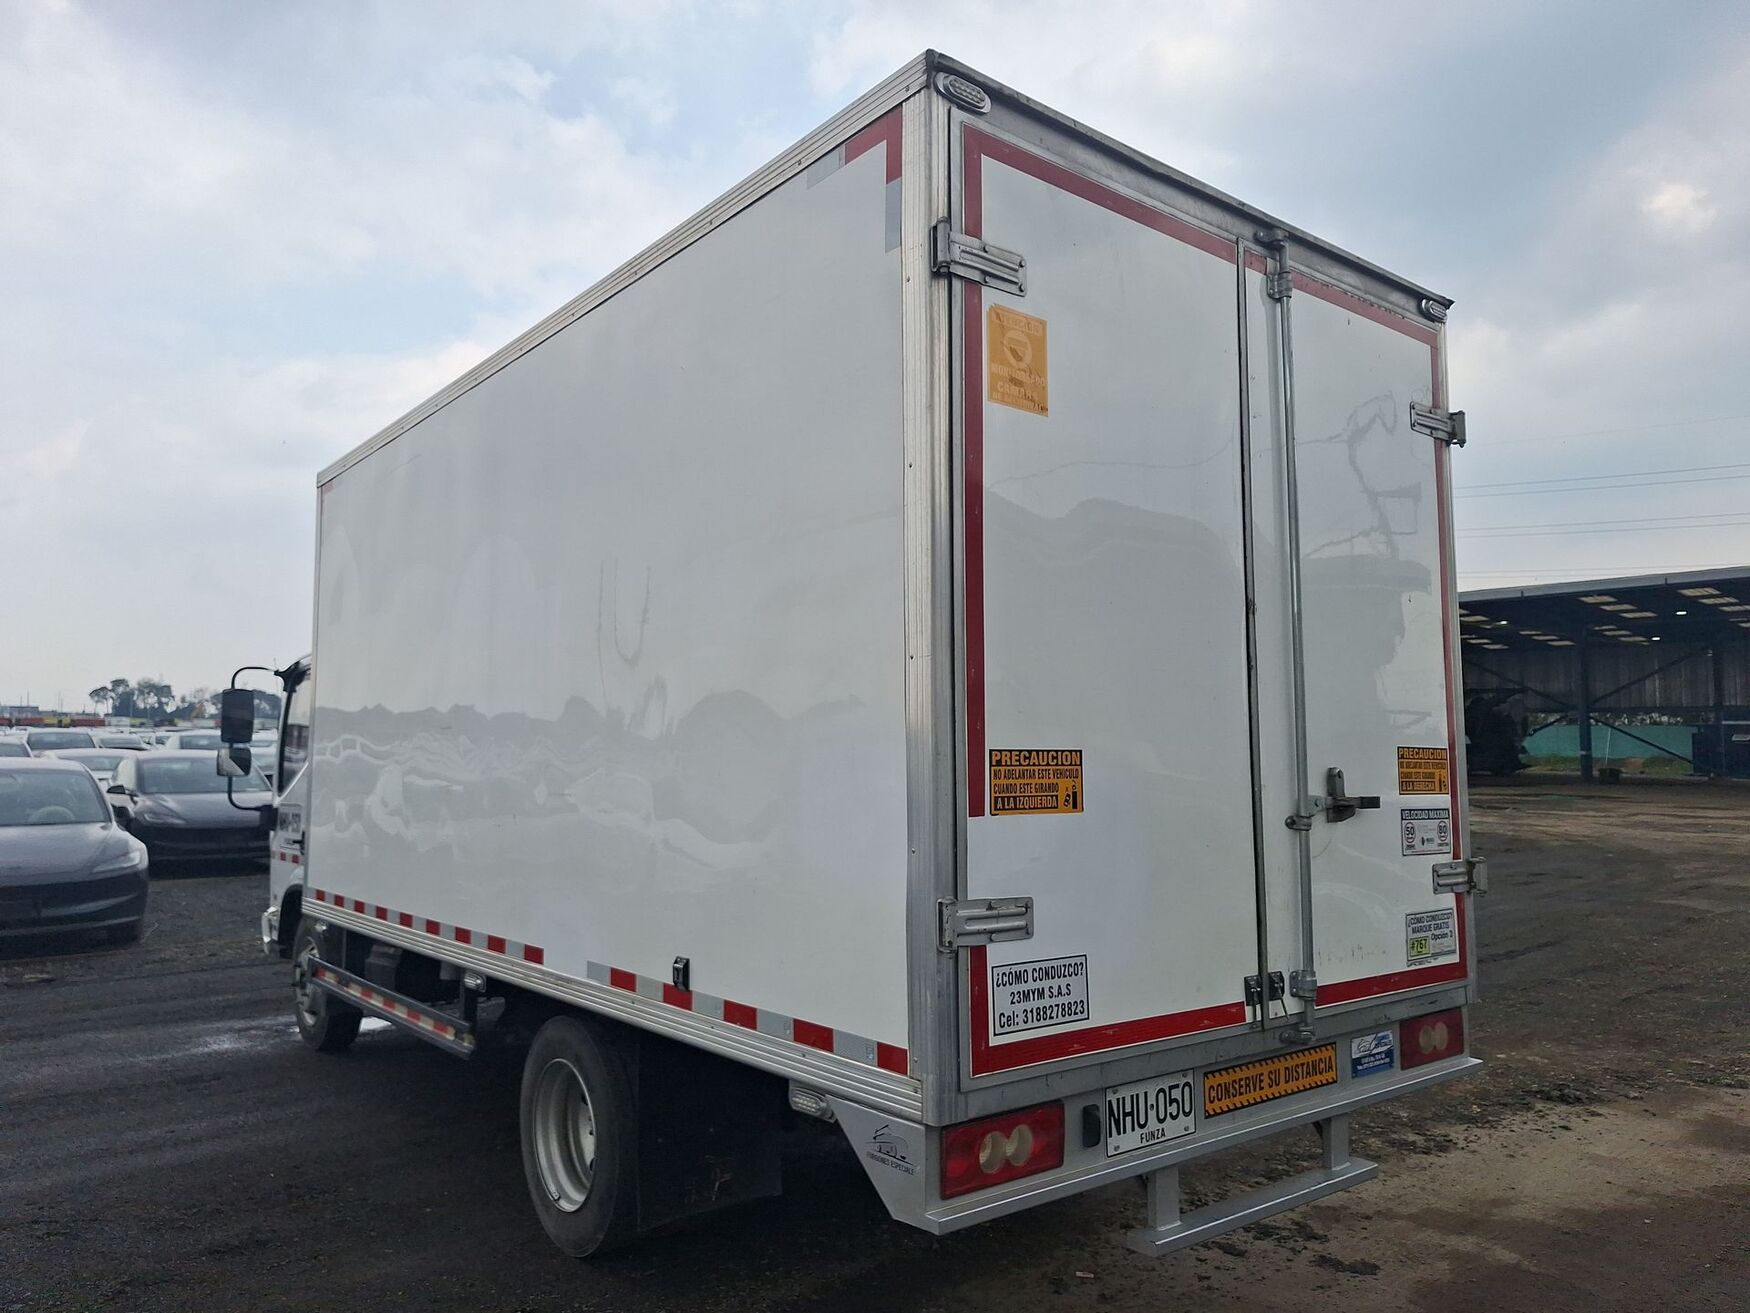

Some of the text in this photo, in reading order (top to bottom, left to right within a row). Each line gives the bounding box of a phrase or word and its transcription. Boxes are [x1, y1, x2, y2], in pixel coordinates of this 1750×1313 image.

[992, 751, 1080, 766] PRECAUCION
[1399, 748, 1447, 760] PRECAUCION
[993, 768, 1079, 780] NO ADELANTAR ESTE VEHICULO
[993, 782, 1059, 794] CUANDO ESTE GIRANDO
[997, 796, 1057, 809] A LA IZQUIERDA
[1402, 810, 1428, 819] VELOCIDAD
[1405, 826, 1415, 836] 50
[1410, 939, 1427, 950] #767
[995, 962, 1084, 988] ¿CÓMO CONDUZCO?
[1010, 983, 1071, 1005] 23MYM S.A.S
[999, 1000, 1085, 1028] Cel: 3188278823
[1208, 1071, 1264, 1104] CONSERVE
[1268, 1069, 1281, 1089] SU
[1284, 1055, 1334, 1084] DISTANCIA
[1140, 1127, 1166, 1144] FUNZA
